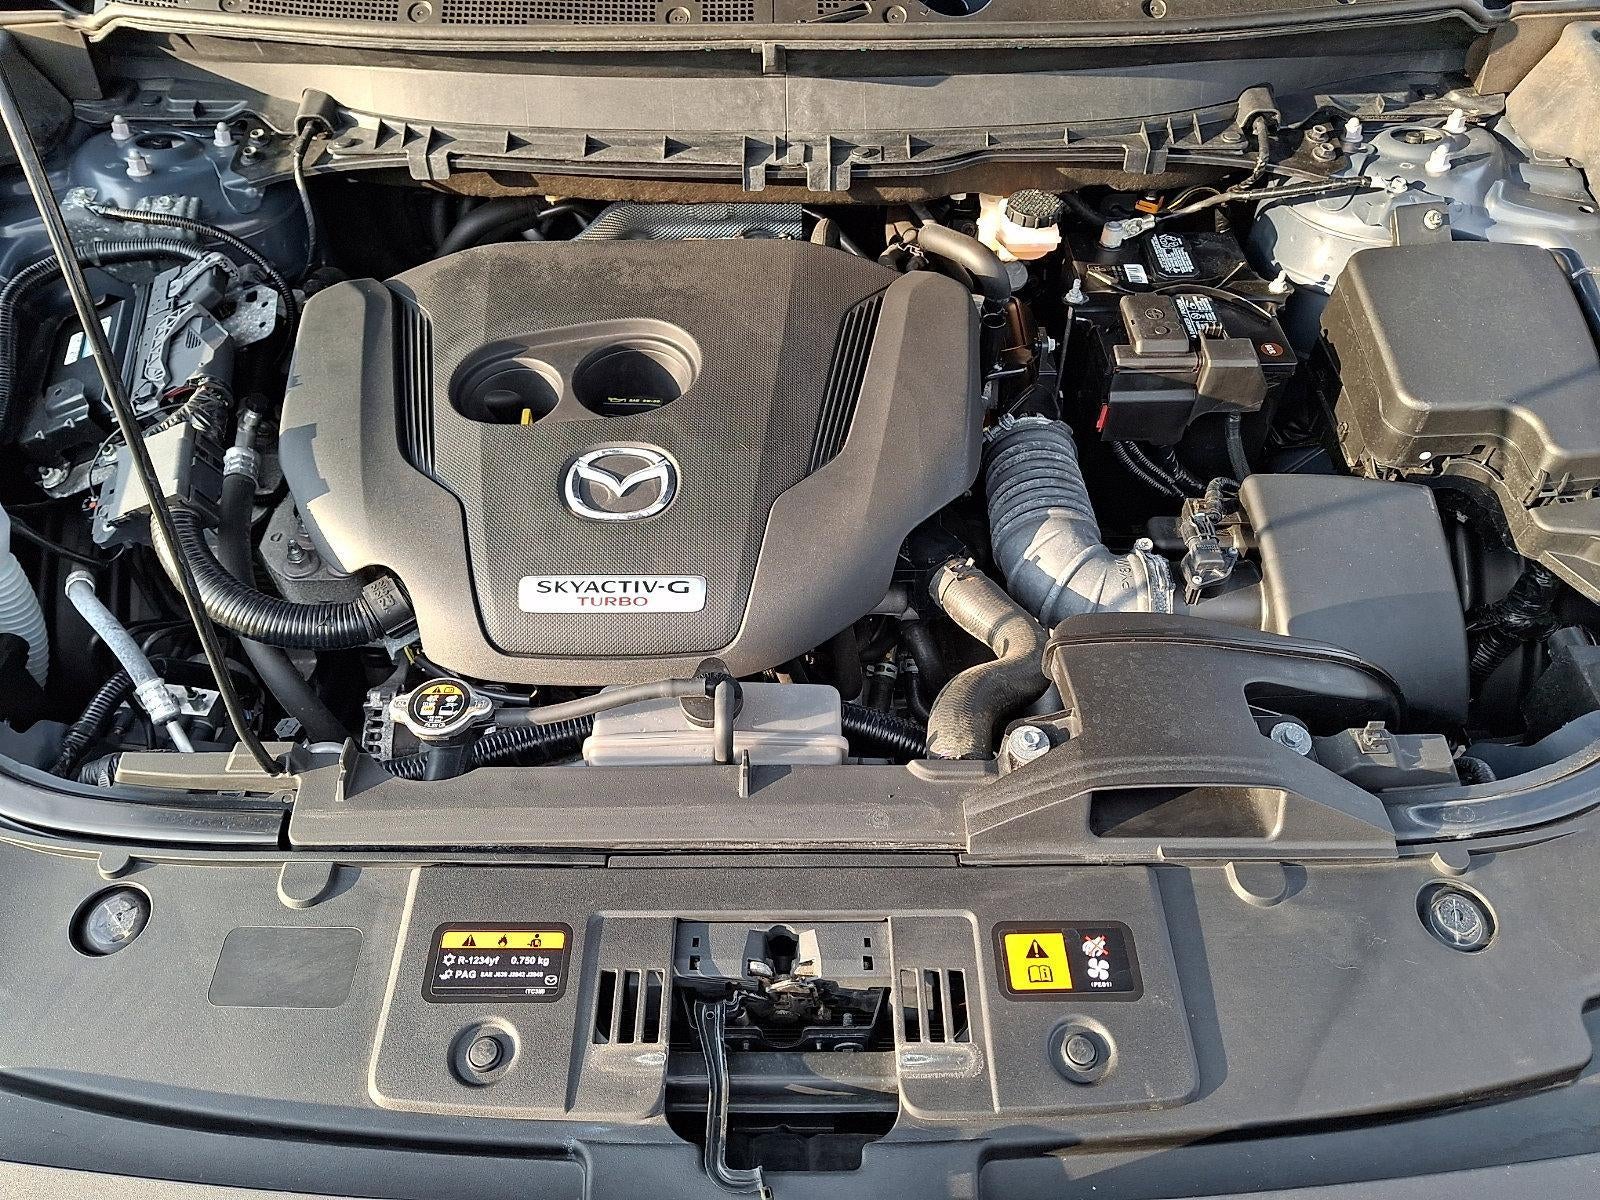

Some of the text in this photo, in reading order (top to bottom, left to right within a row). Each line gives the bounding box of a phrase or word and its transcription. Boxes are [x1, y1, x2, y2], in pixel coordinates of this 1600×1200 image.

[536, 580, 690, 594] SKYACTIV-G
[577, 596, 648, 607] TURBO
[457, 955, 550, 967] R-1234yf 0.750 kg
[454, 969, 477, 979] PAG
